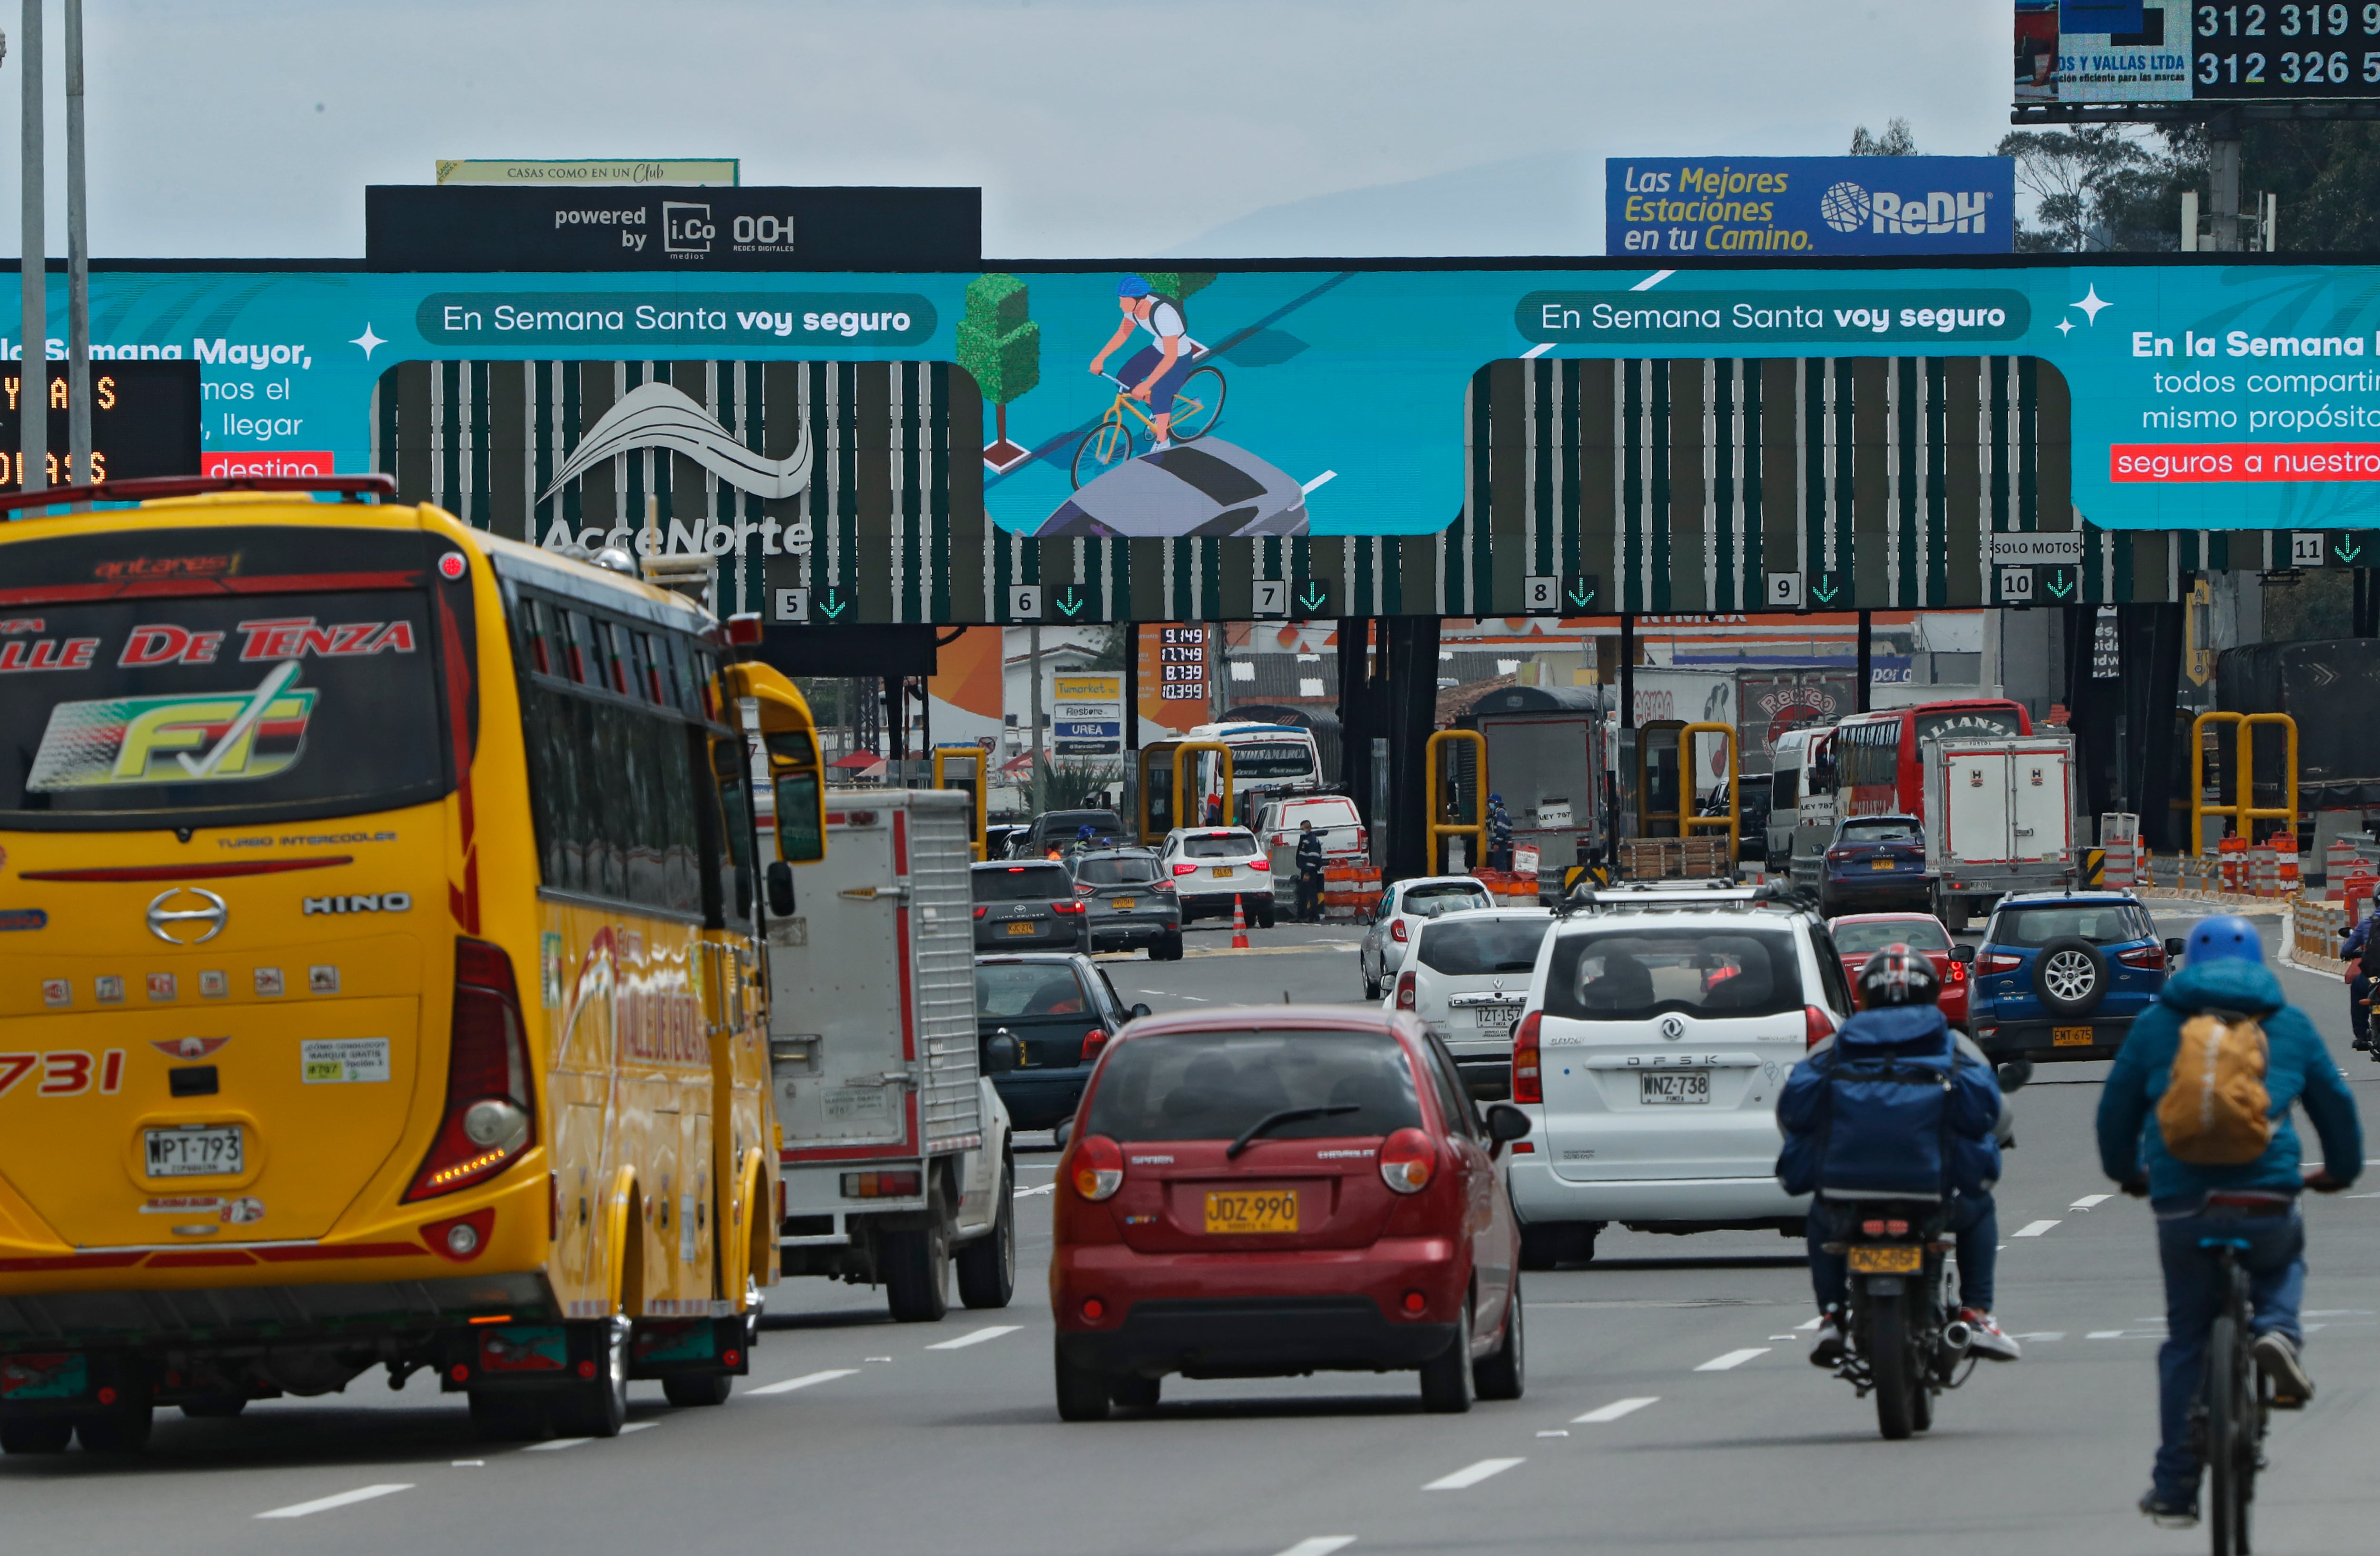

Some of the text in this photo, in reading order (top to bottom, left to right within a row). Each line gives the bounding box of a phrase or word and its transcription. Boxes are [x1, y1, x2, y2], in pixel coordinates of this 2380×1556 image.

[2198, 3, 2380, 37] 312 319 9
[2080, 56, 2088, 70] Y
[2093, 55, 2146, 70] VALLAS
[2151, 55, 2184, 70] LTDA
[2198, 52, 2266, 83] 312
[2280, 51, 2348, 83] 326
[2119, 74, 2137, 83] para
[2140, 72, 2152, 81] las
[507, 163, 664, 183] CASAS COMO EN UN Club
[1625, 167, 1788, 199] Las Mejores
[555, 207, 646, 229] powered
[1625, 196, 1773, 222] Estaciones
[622, 230, 647, 251] by
[1625, 224, 1814, 251] en tu Camino.
[445, 306, 911, 336] En Semana Santa voy seguro
[1542, 303, 2005, 333] En Semana Santa voy seguro
[46, 338, 182, 360] Smana
[193, 339, 312, 370] Mayor,
[2132, 331, 2364, 357] En la Semana
[267, 378, 289, 399] el
[2154, 370, 2236, 393] todos
[224, 413, 303, 440] llegar
[2143, 406, 2237, 429] mismo
[211, 459, 317, 478] destino
[2118, 454, 2232, 478] seguros
[2244, 455, 2262, 472] a
[542, 516, 813, 556] AcceNorte
[1995, 541, 2079, 555] SOLO MOTOS
[2296, 540, 2320, 559] 11
[1535, 584, 1547, 601] 8
[1777, 580, 1790, 597] 9
[2005, 576, 2030, 594] 10
[787, 596, 798, 613] 5
[1019, 593, 1031, 610] 6
[1262, 588, 1275, 605] 7
[117, 623, 226, 668] DE
[237, 617, 416, 661] TENZA
[1758, 688, 1836, 717] Recreo
[1072, 724, 1103, 735] UREA
[218, 832, 397, 848] TURBO INTERCOOLER
[303, 892, 411, 915] HINO
[1628, 1055, 1718, 1066] DFSK
[0, 1050, 126, 1097] 731
[1317, 1149, 1376, 1159] CHEVROLET
